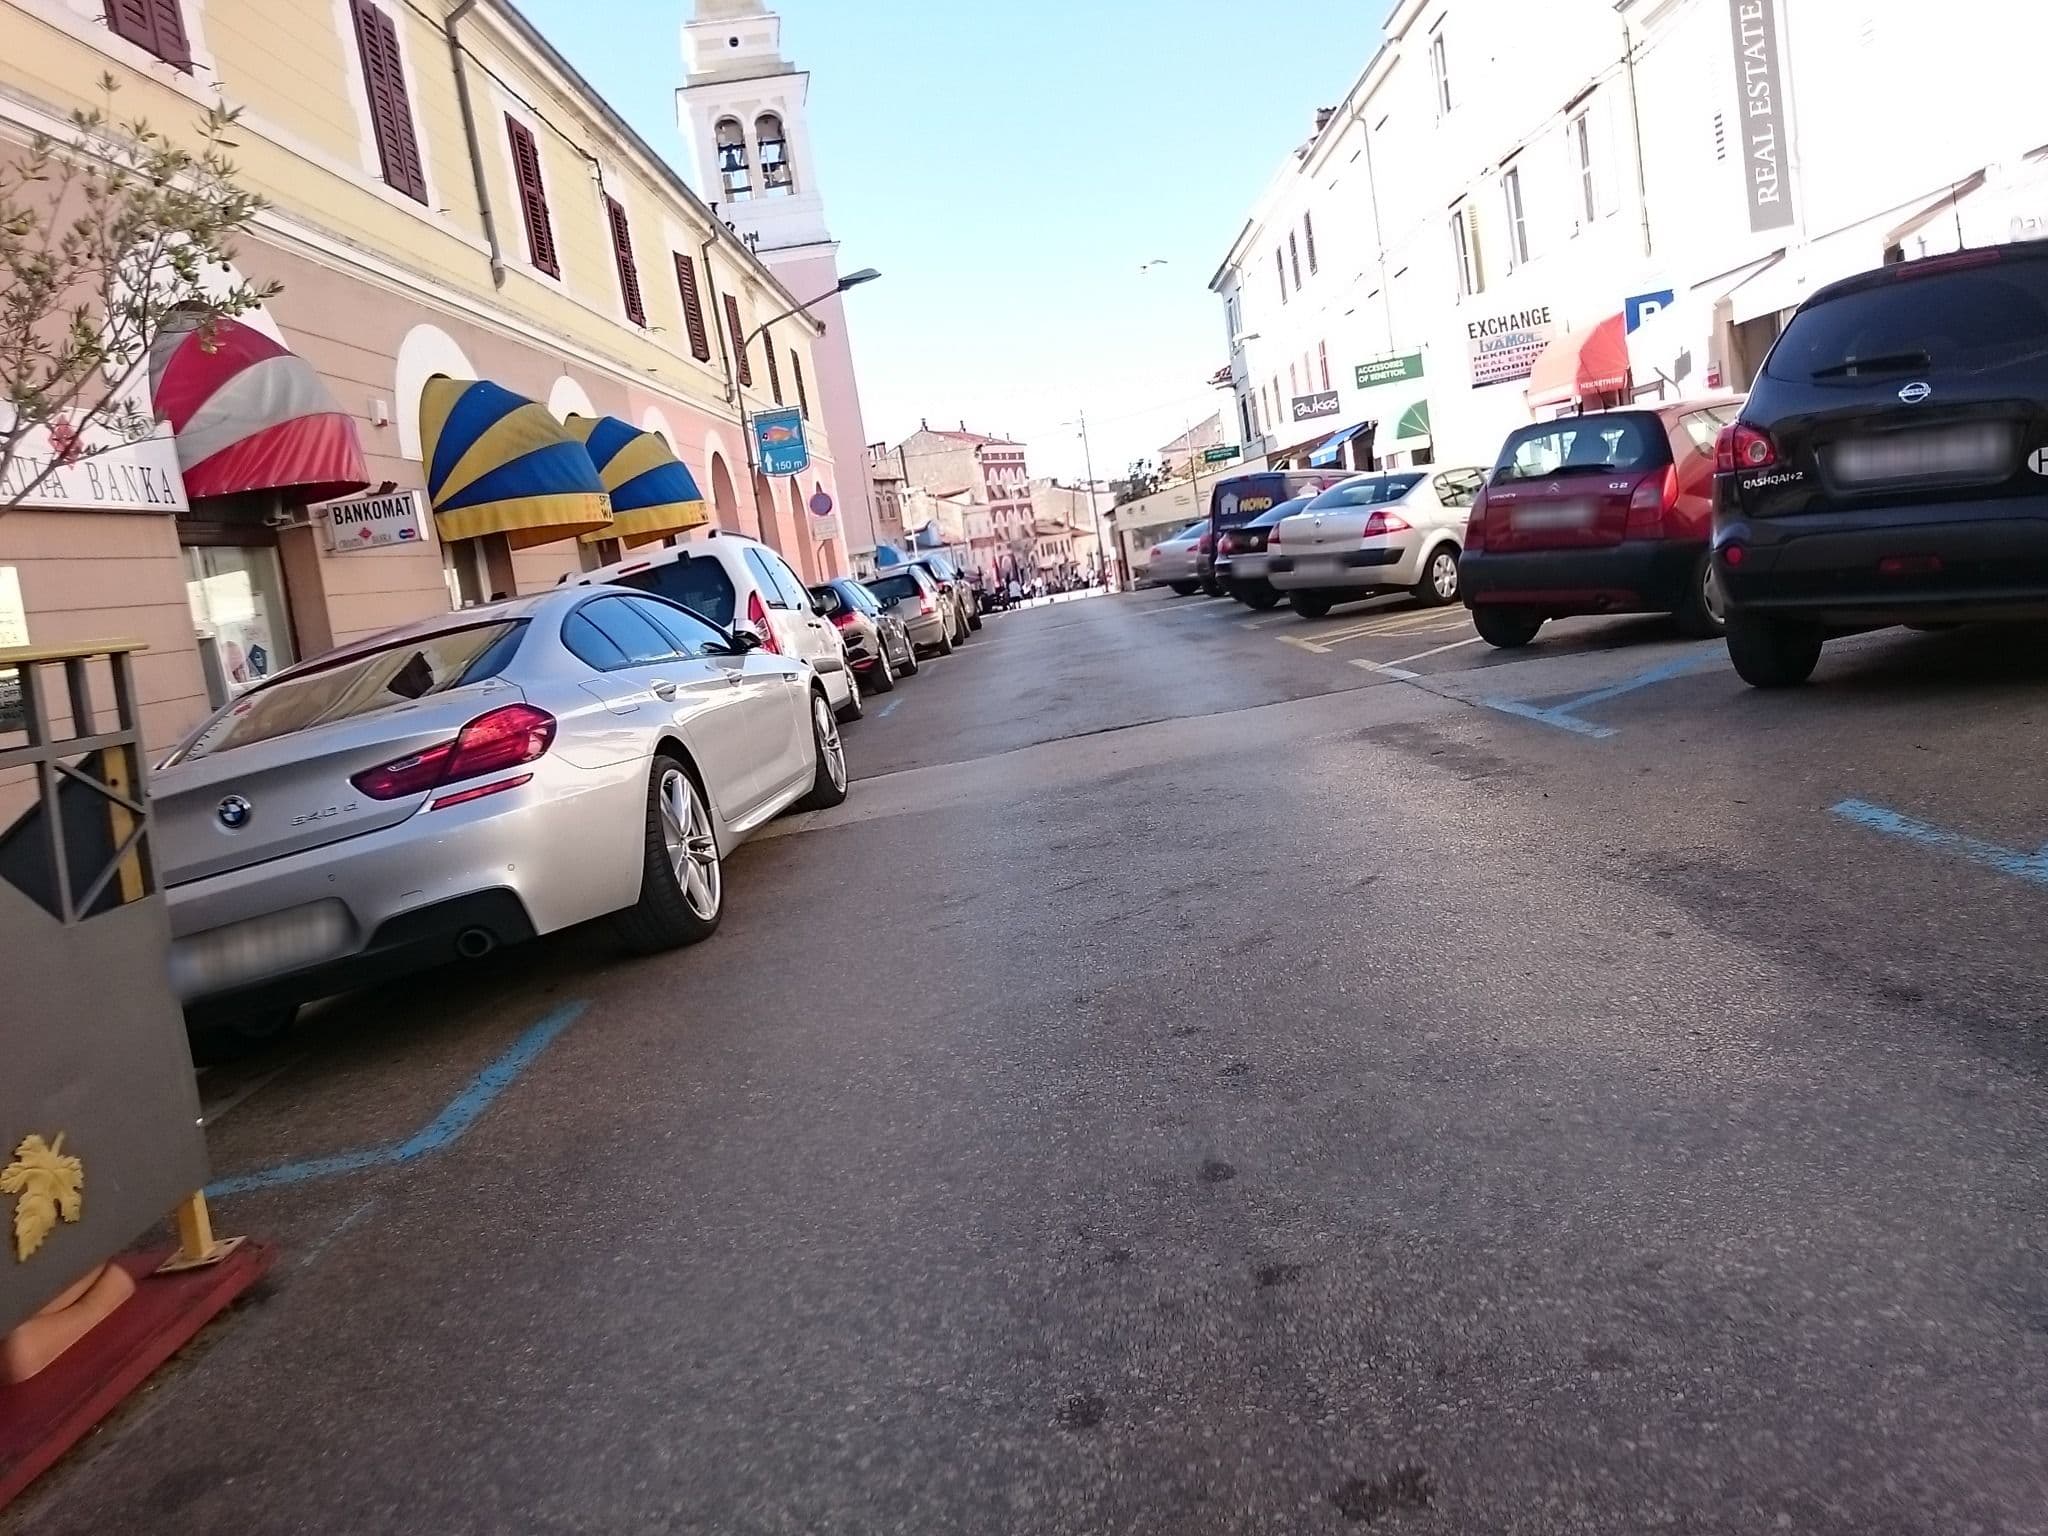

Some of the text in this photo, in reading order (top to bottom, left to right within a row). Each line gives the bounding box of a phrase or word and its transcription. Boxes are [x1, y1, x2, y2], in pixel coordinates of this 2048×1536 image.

[1739, 1, 1780, 206] REAL ESTATE
[1467, 306, 1552, 339] EXCHANGE
[1358, 360, 1404, 375] ACCESSORIES
[775, 460, 803, 471] 150 m
[85, 461, 177, 504] BANKA
[332, 496, 411, 526] BANKOMAT
